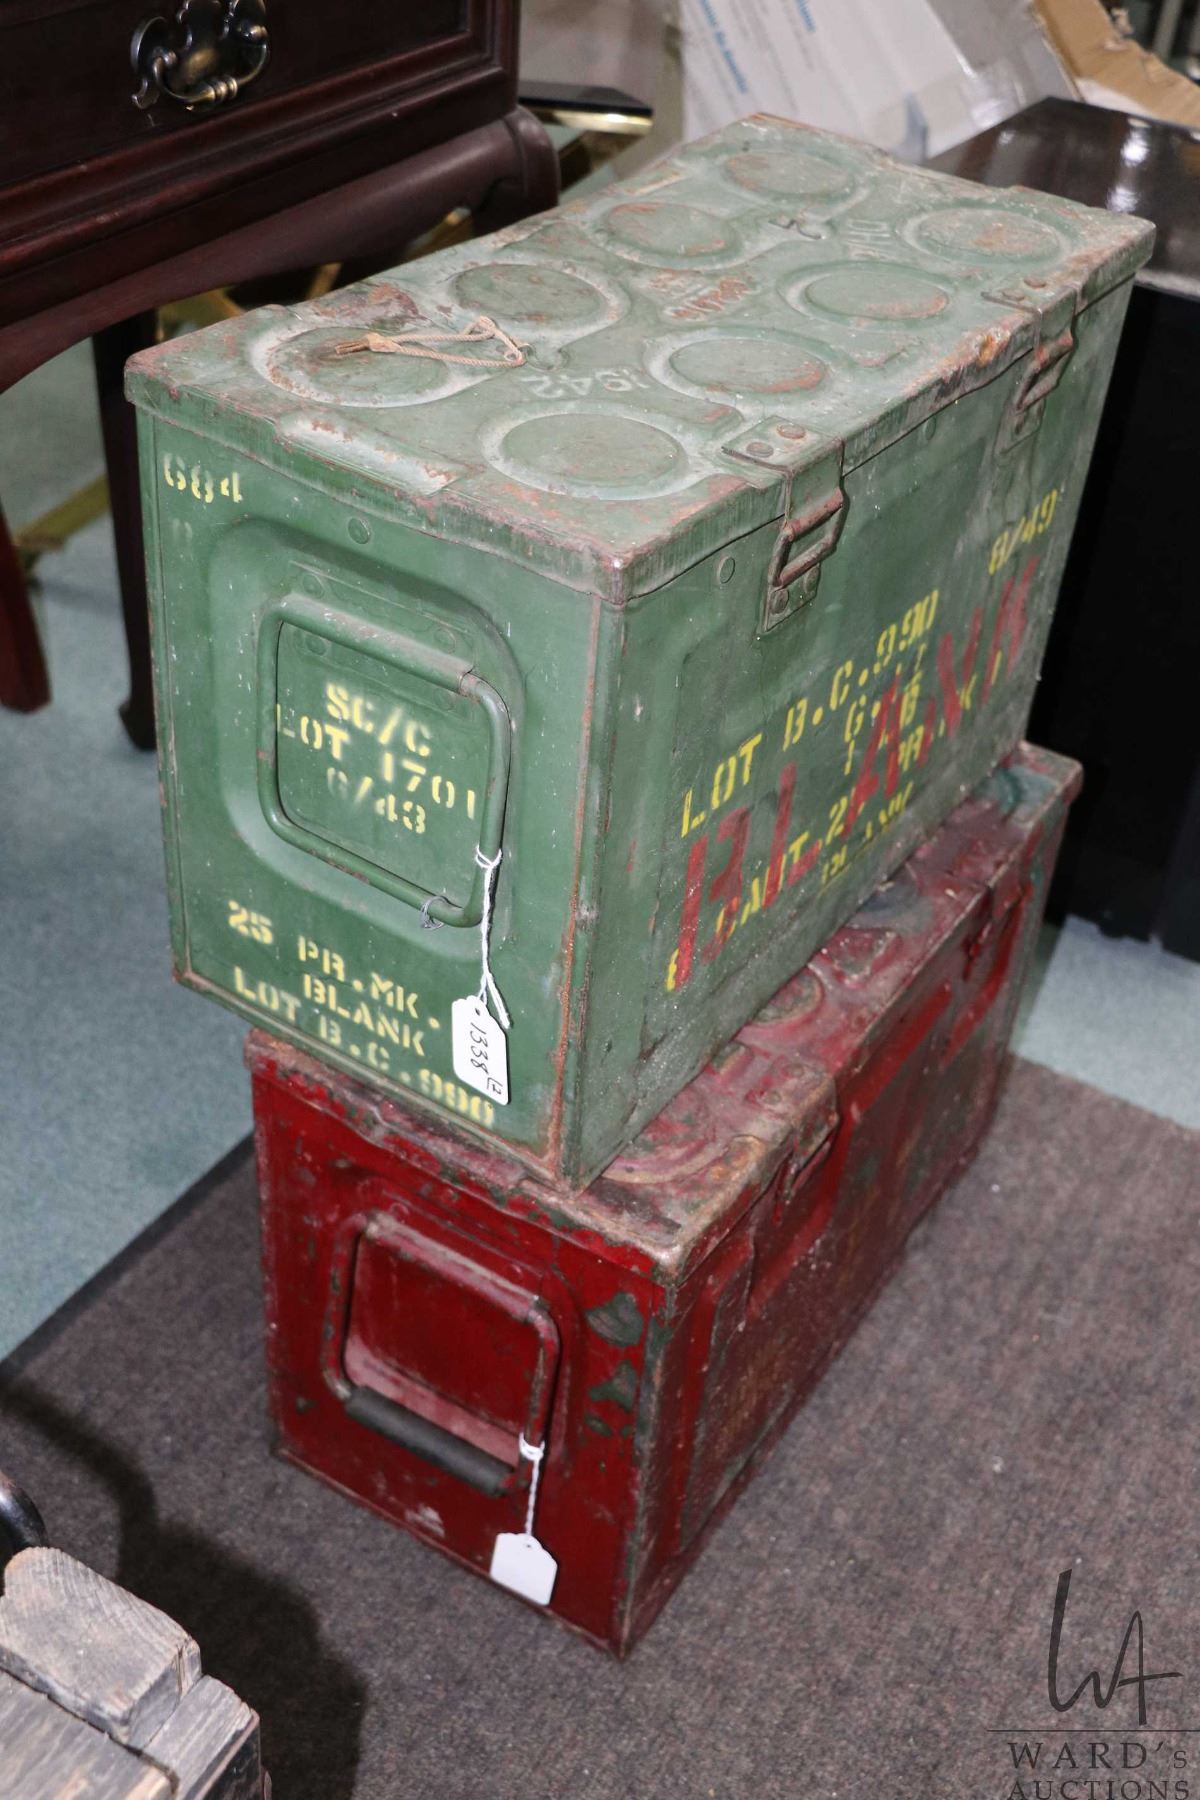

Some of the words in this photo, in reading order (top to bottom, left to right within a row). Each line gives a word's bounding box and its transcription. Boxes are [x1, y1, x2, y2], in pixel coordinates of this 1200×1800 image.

[519, 368, 651, 399] 1942
[276, 703, 351, 760] LOT
[381, 751, 476, 819] 1701
[680, 731, 763, 838] LOT
[782, 591, 939, 751] B.C.990
[673, 556, 1040, 990] BLANK
[228, 900, 273, 945] 25
[233, 965, 301, 1023] LOT
[318, 1015, 495, 1127] B.C.990
[303, 972, 425, 1057] BLANK
[470, 1022, 490, 1076] 1338
